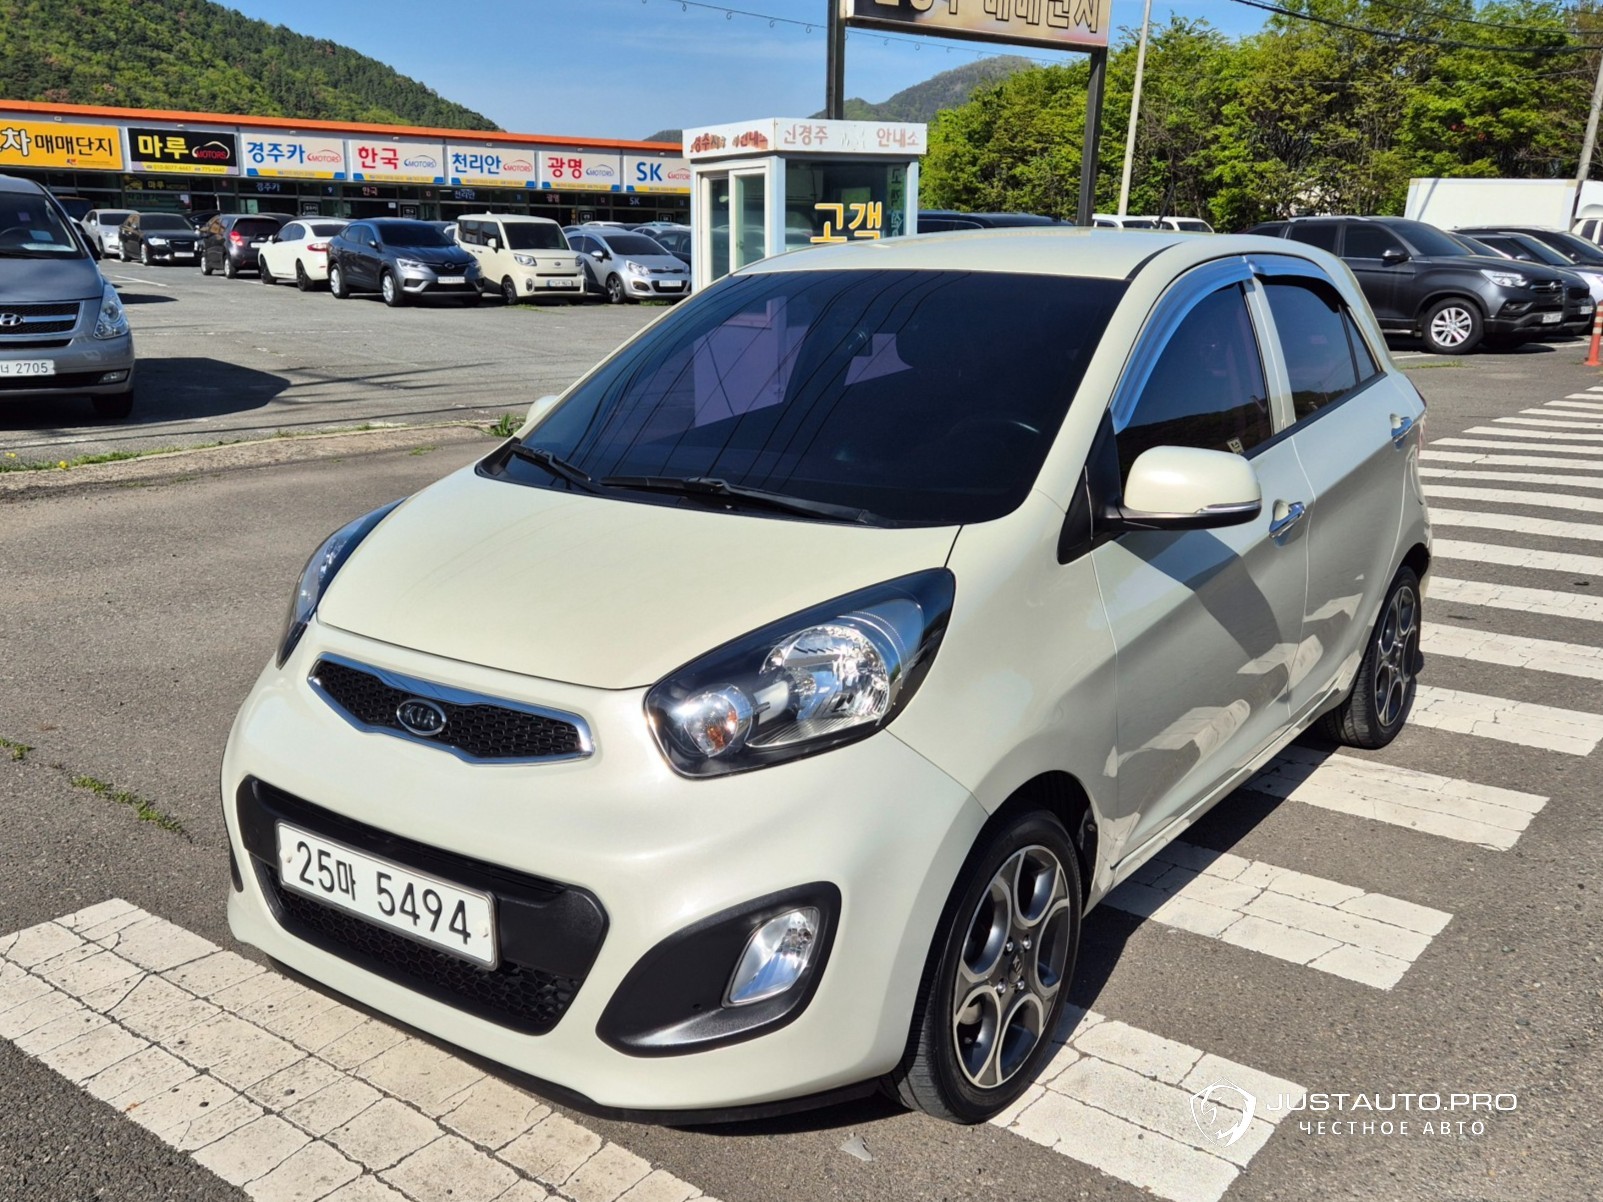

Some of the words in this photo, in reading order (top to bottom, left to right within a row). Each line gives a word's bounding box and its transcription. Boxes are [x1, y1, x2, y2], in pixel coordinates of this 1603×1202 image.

[0, 127, 31, 157] 차
[34, 134, 113, 157] 매매단지
[137, 135, 190, 160] 마루
[196, 150, 227, 160] MOTORS
[783, 125, 829, 145] 신경주
[876, 127, 919, 147] 안내소
[247, 142, 306, 164] 경주카
[311, 155, 339, 163] MOTORS
[358, 146, 400, 170] 한국
[408, 160, 435, 168] MOTORS
[452, 152, 502, 175] 천리안
[547, 157, 583, 180] 광명
[590, 169, 612, 177] MOTORS
[636, 161, 663, 182] SK
[671, 172, 691, 180] MOTOR
[629, 196, 640, 205] SK
[810, 201, 883, 243] 고객
[16, 362, 49, 374] 2705
[404, 704, 435, 729] KIA
[296, 840, 356, 902] 25마
[376, 871, 472, 945] 5494
